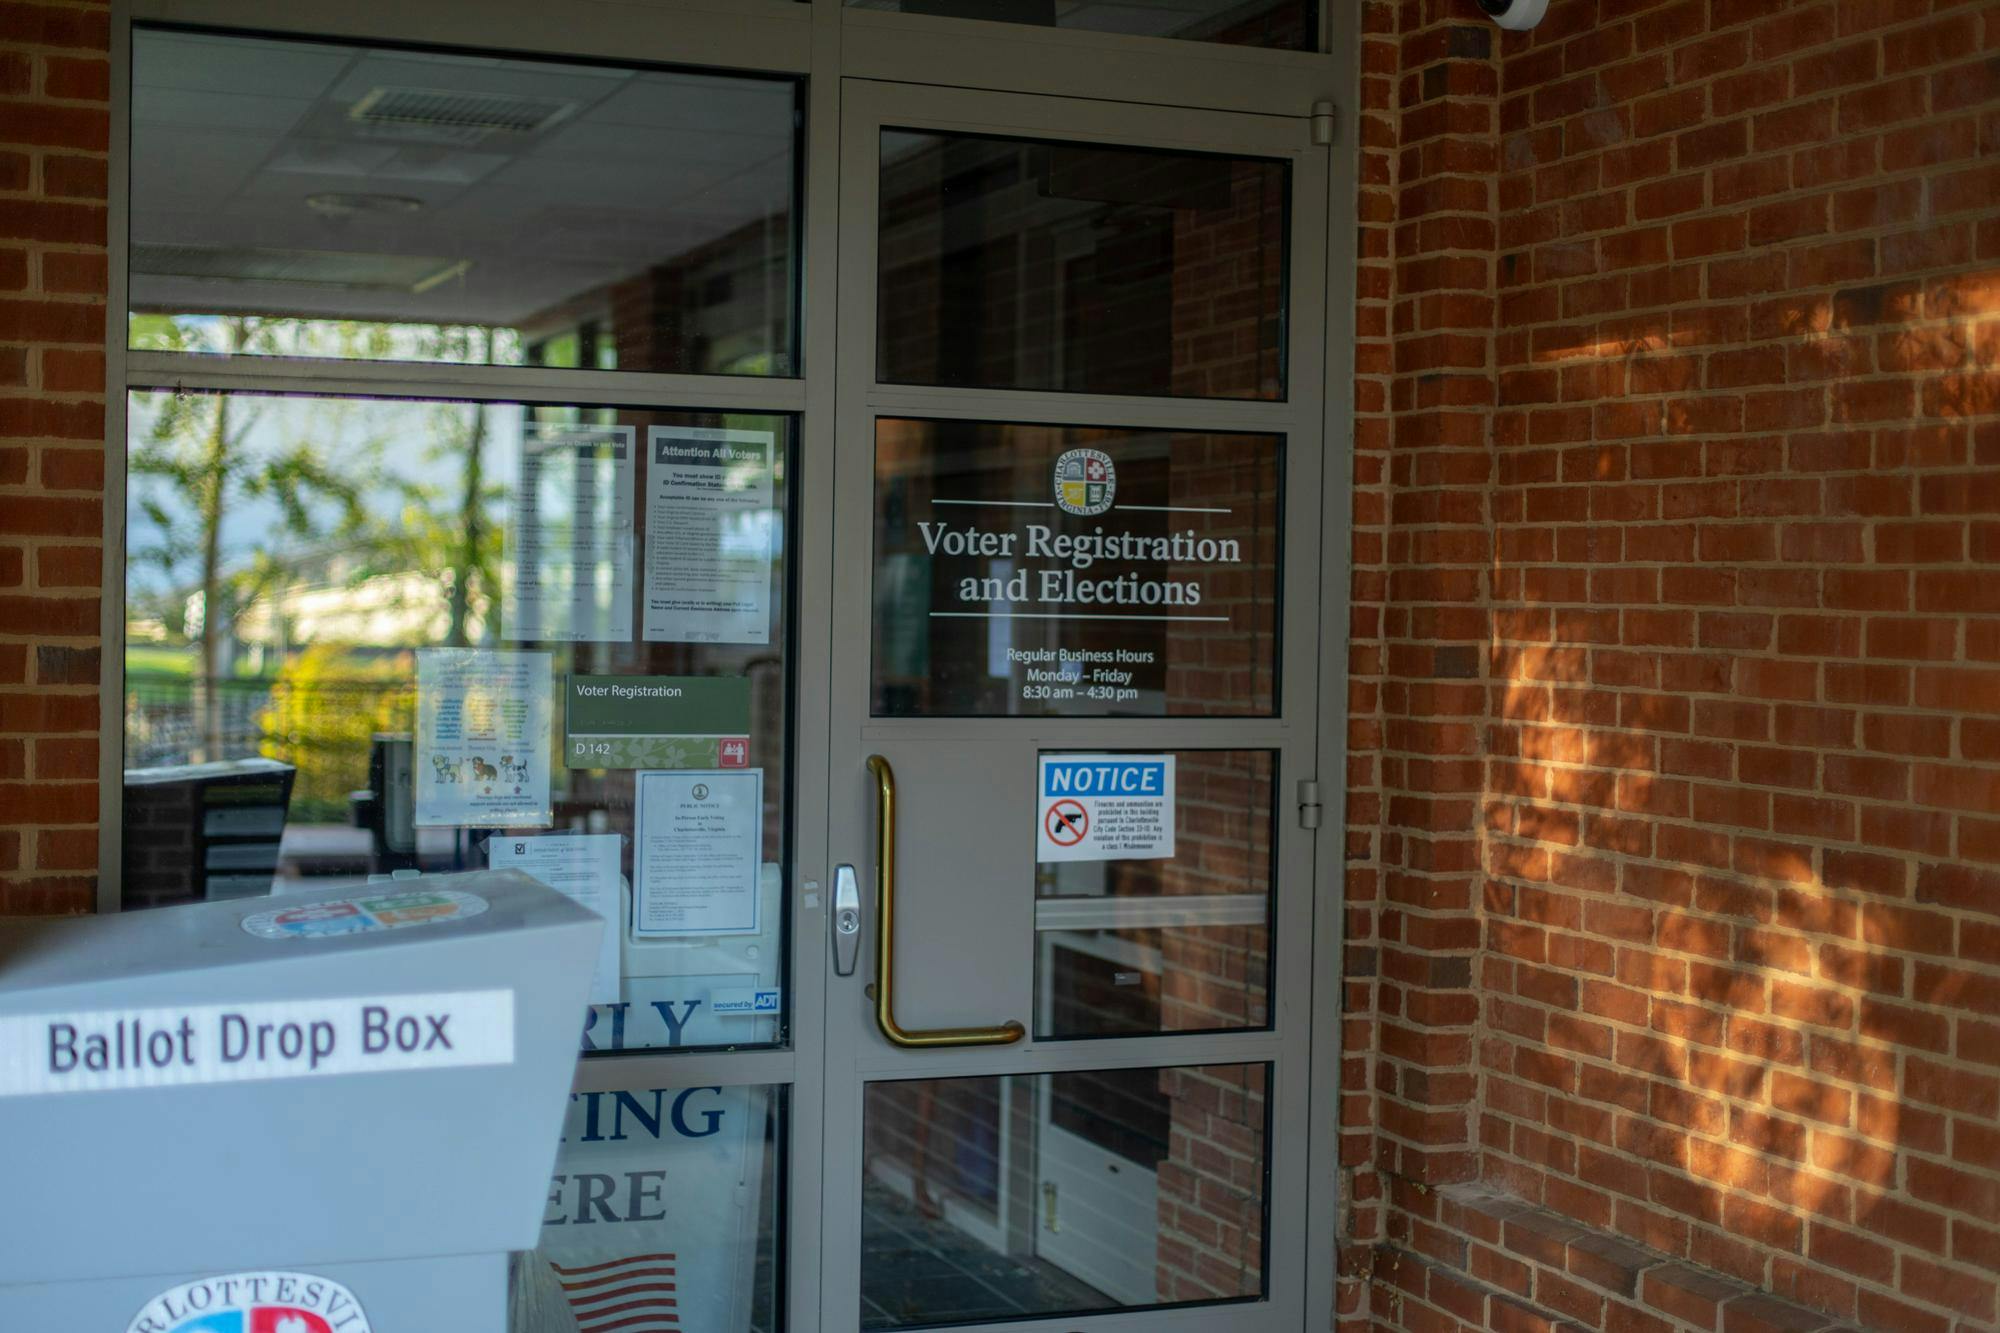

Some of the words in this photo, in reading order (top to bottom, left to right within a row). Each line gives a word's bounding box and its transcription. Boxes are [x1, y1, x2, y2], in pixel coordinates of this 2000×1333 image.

[662, 446, 710, 458] Attention
[712, 448, 727, 458] All
[728, 449, 761, 460] Voters
[1055, 449, 1114, 486] CHARLOTTESVILLE
[1055, 489, 1094, 515] VIRGINIA
[917, 522, 1017, 557] Voter
[1025, 525, 1241, 568] Registration
[959, 568, 1029, 601] and
[1038, 569, 1200, 605] Elections
[1006, 648, 1056, 664] Regular
[1059, 648, 1113, 663] Business
[1116, 649, 1154, 663] Hours
[1026, 668, 1080, 684] Monday
[1093, 668, 1133, 685] Friday
[576, 685, 608, 697] Voter
[611, 684, 682, 700] Registration
[1022, 686, 1050, 699] 8:30
[1052, 688, 1073, 699] am
[1087, 686, 1114, 699] 4:30
[1116, 688, 1138, 702] pm
[576, 743, 586, 754] D
[589, 743, 610, 755] 142
[1051, 767, 1158, 792] NOTICE
[713, 1000, 743, 1009] secured
[744, 1000, 753, 1010] by
[756, 994, 777, 1008] ADT
[48, 1016, 195, 1074] Ballot
[219, 1013, 336, 1070] Drop
[361, 1005, 454, 1055] Box
